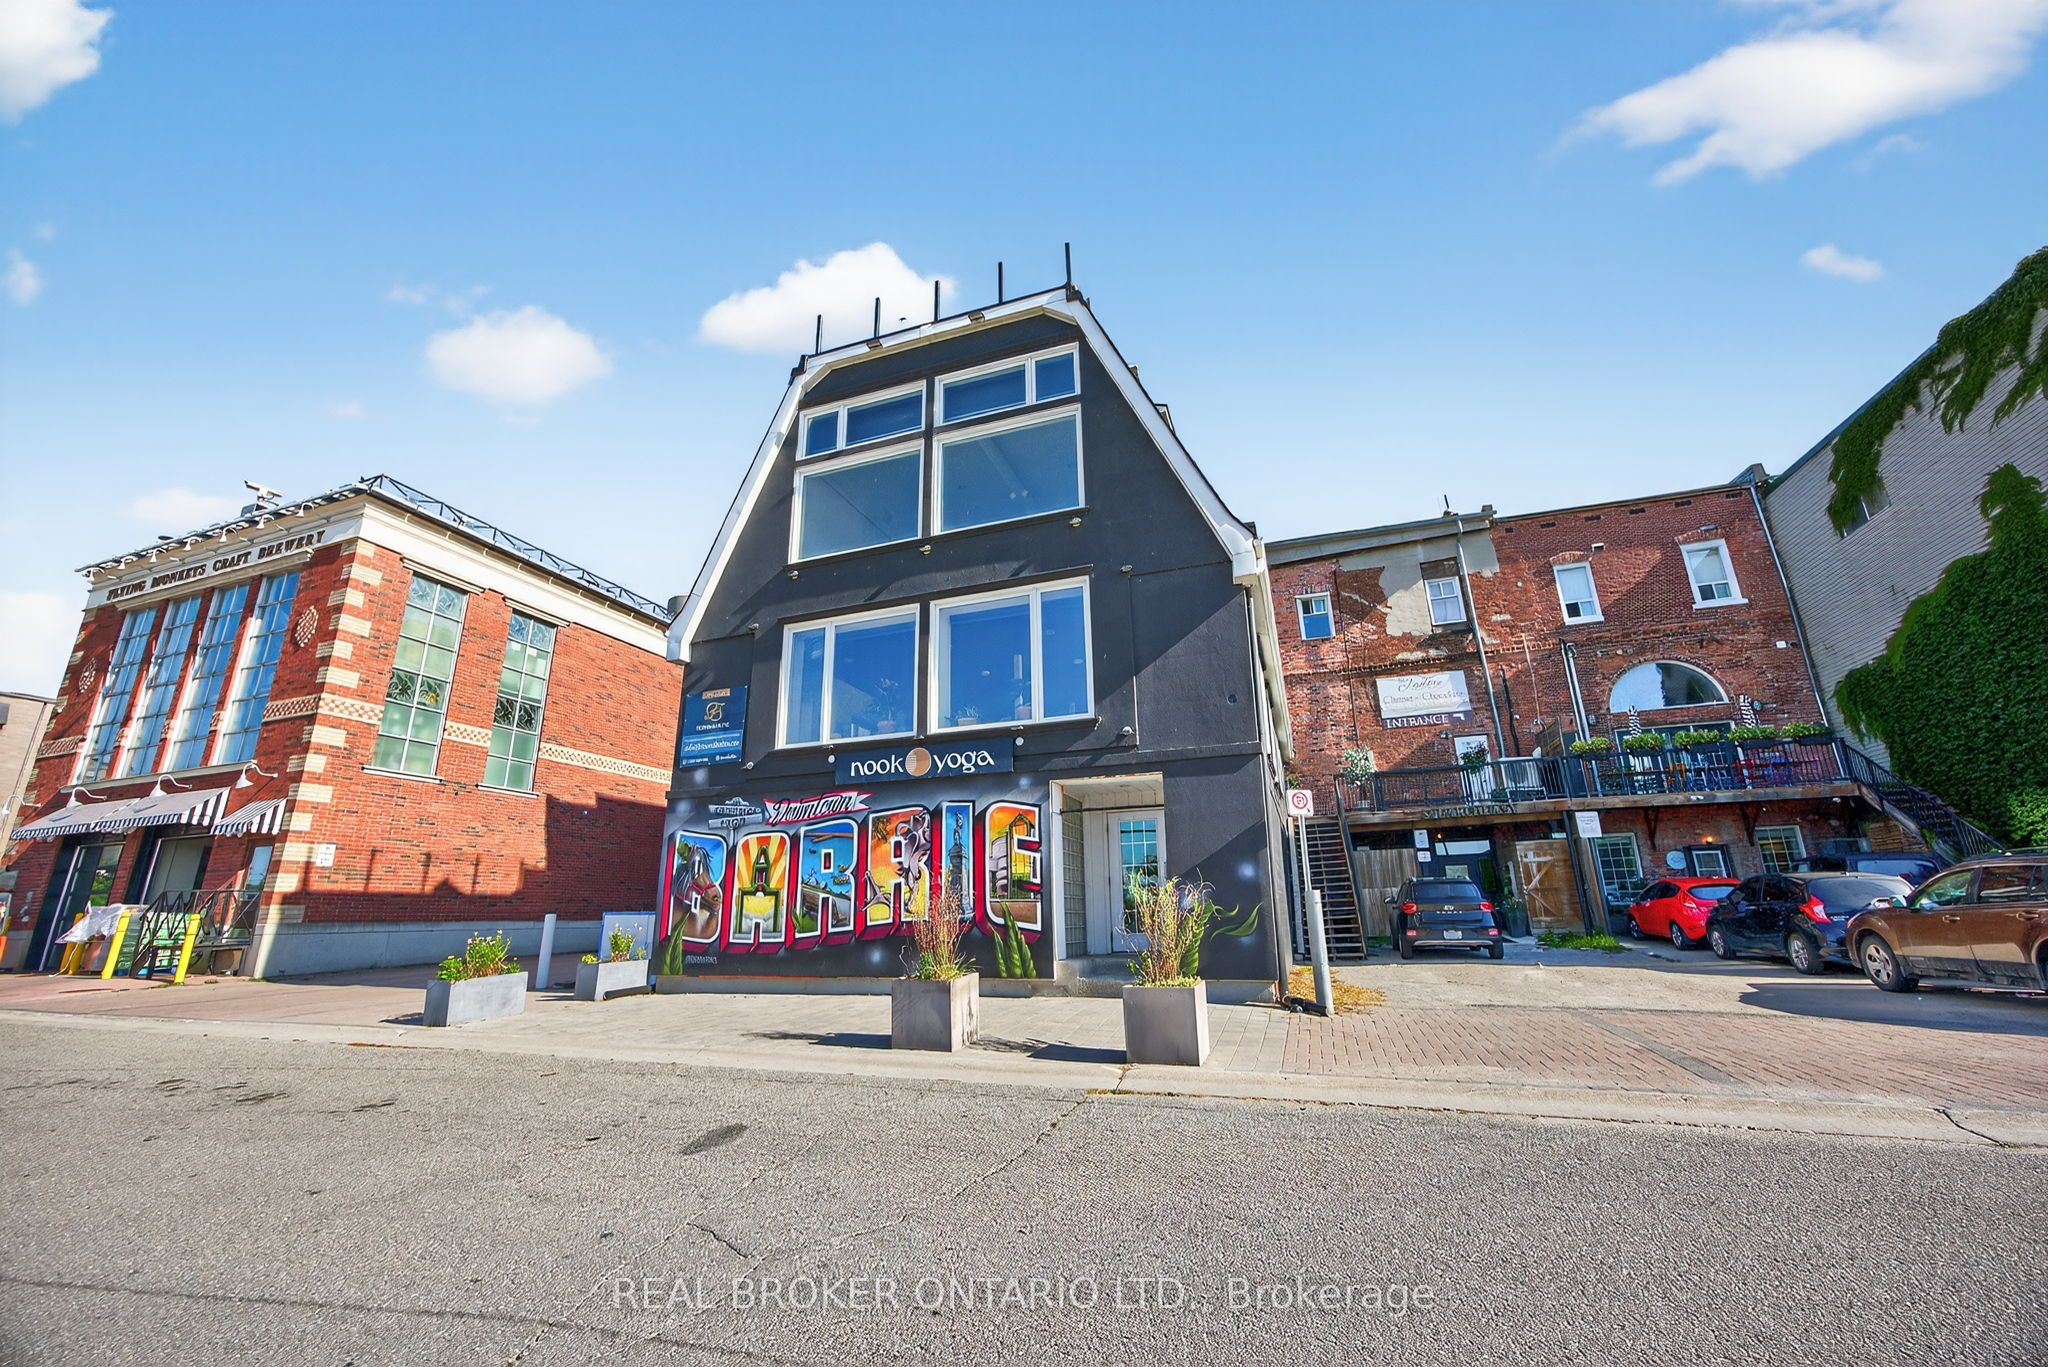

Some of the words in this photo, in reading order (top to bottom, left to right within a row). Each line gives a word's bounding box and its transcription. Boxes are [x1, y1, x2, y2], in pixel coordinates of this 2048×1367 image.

[106, 579, 147, 601] FLYING
[150, 563, 207, 588] MONKEYS
[212, 551, 252, 571] CRAFT
[257, 529, 326, 559] BREWERY
[1386, 713, 1449, 729] ENTRANCE
[850, 754, 904, 777] nook
[932, 750, 995, 773] yoga
[664, 801, 1042, 950] BARRIE
